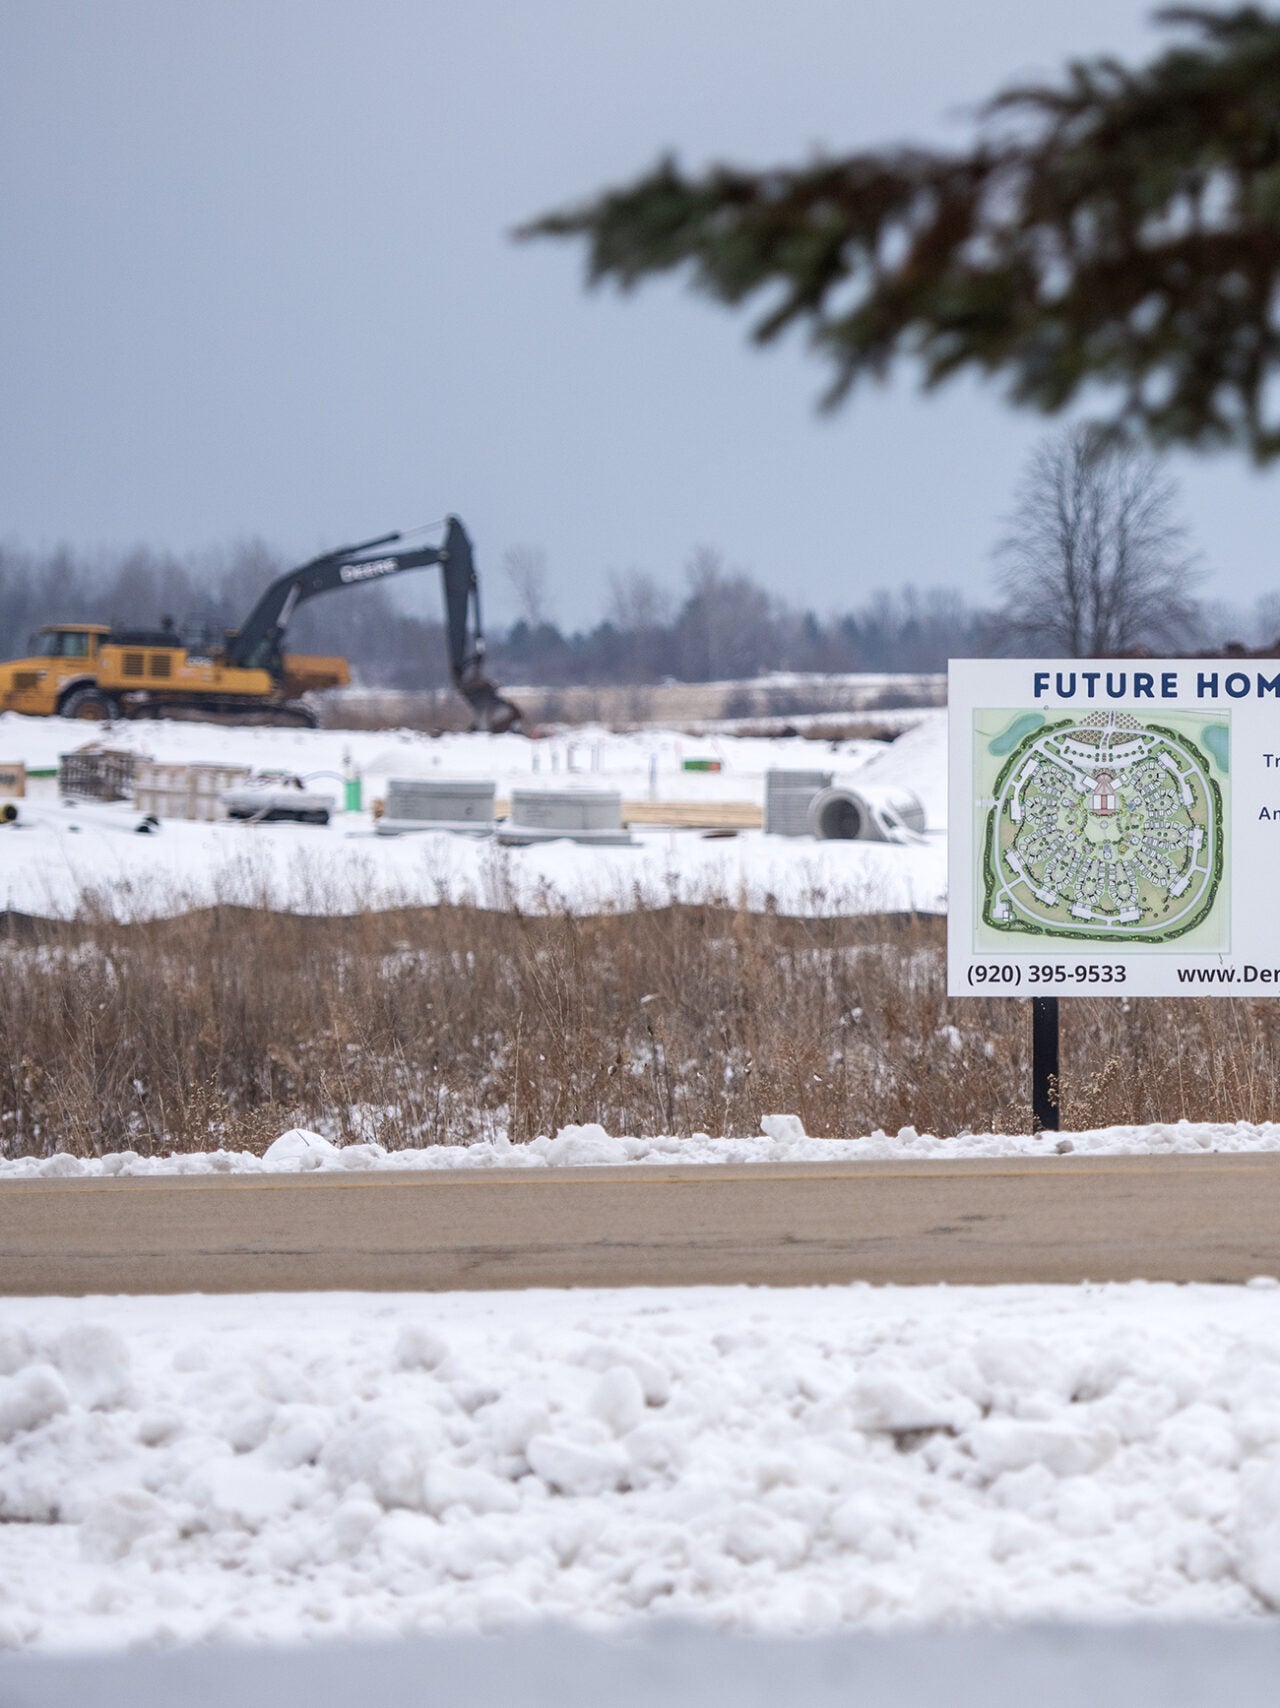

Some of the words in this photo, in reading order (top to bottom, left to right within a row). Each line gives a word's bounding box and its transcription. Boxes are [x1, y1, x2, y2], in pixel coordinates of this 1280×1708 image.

[1033, 672, 1178, 699] FUTURE
[967, 964, 1022, 987] (920)
[1028, 964, 1127, 983] 395-9533
